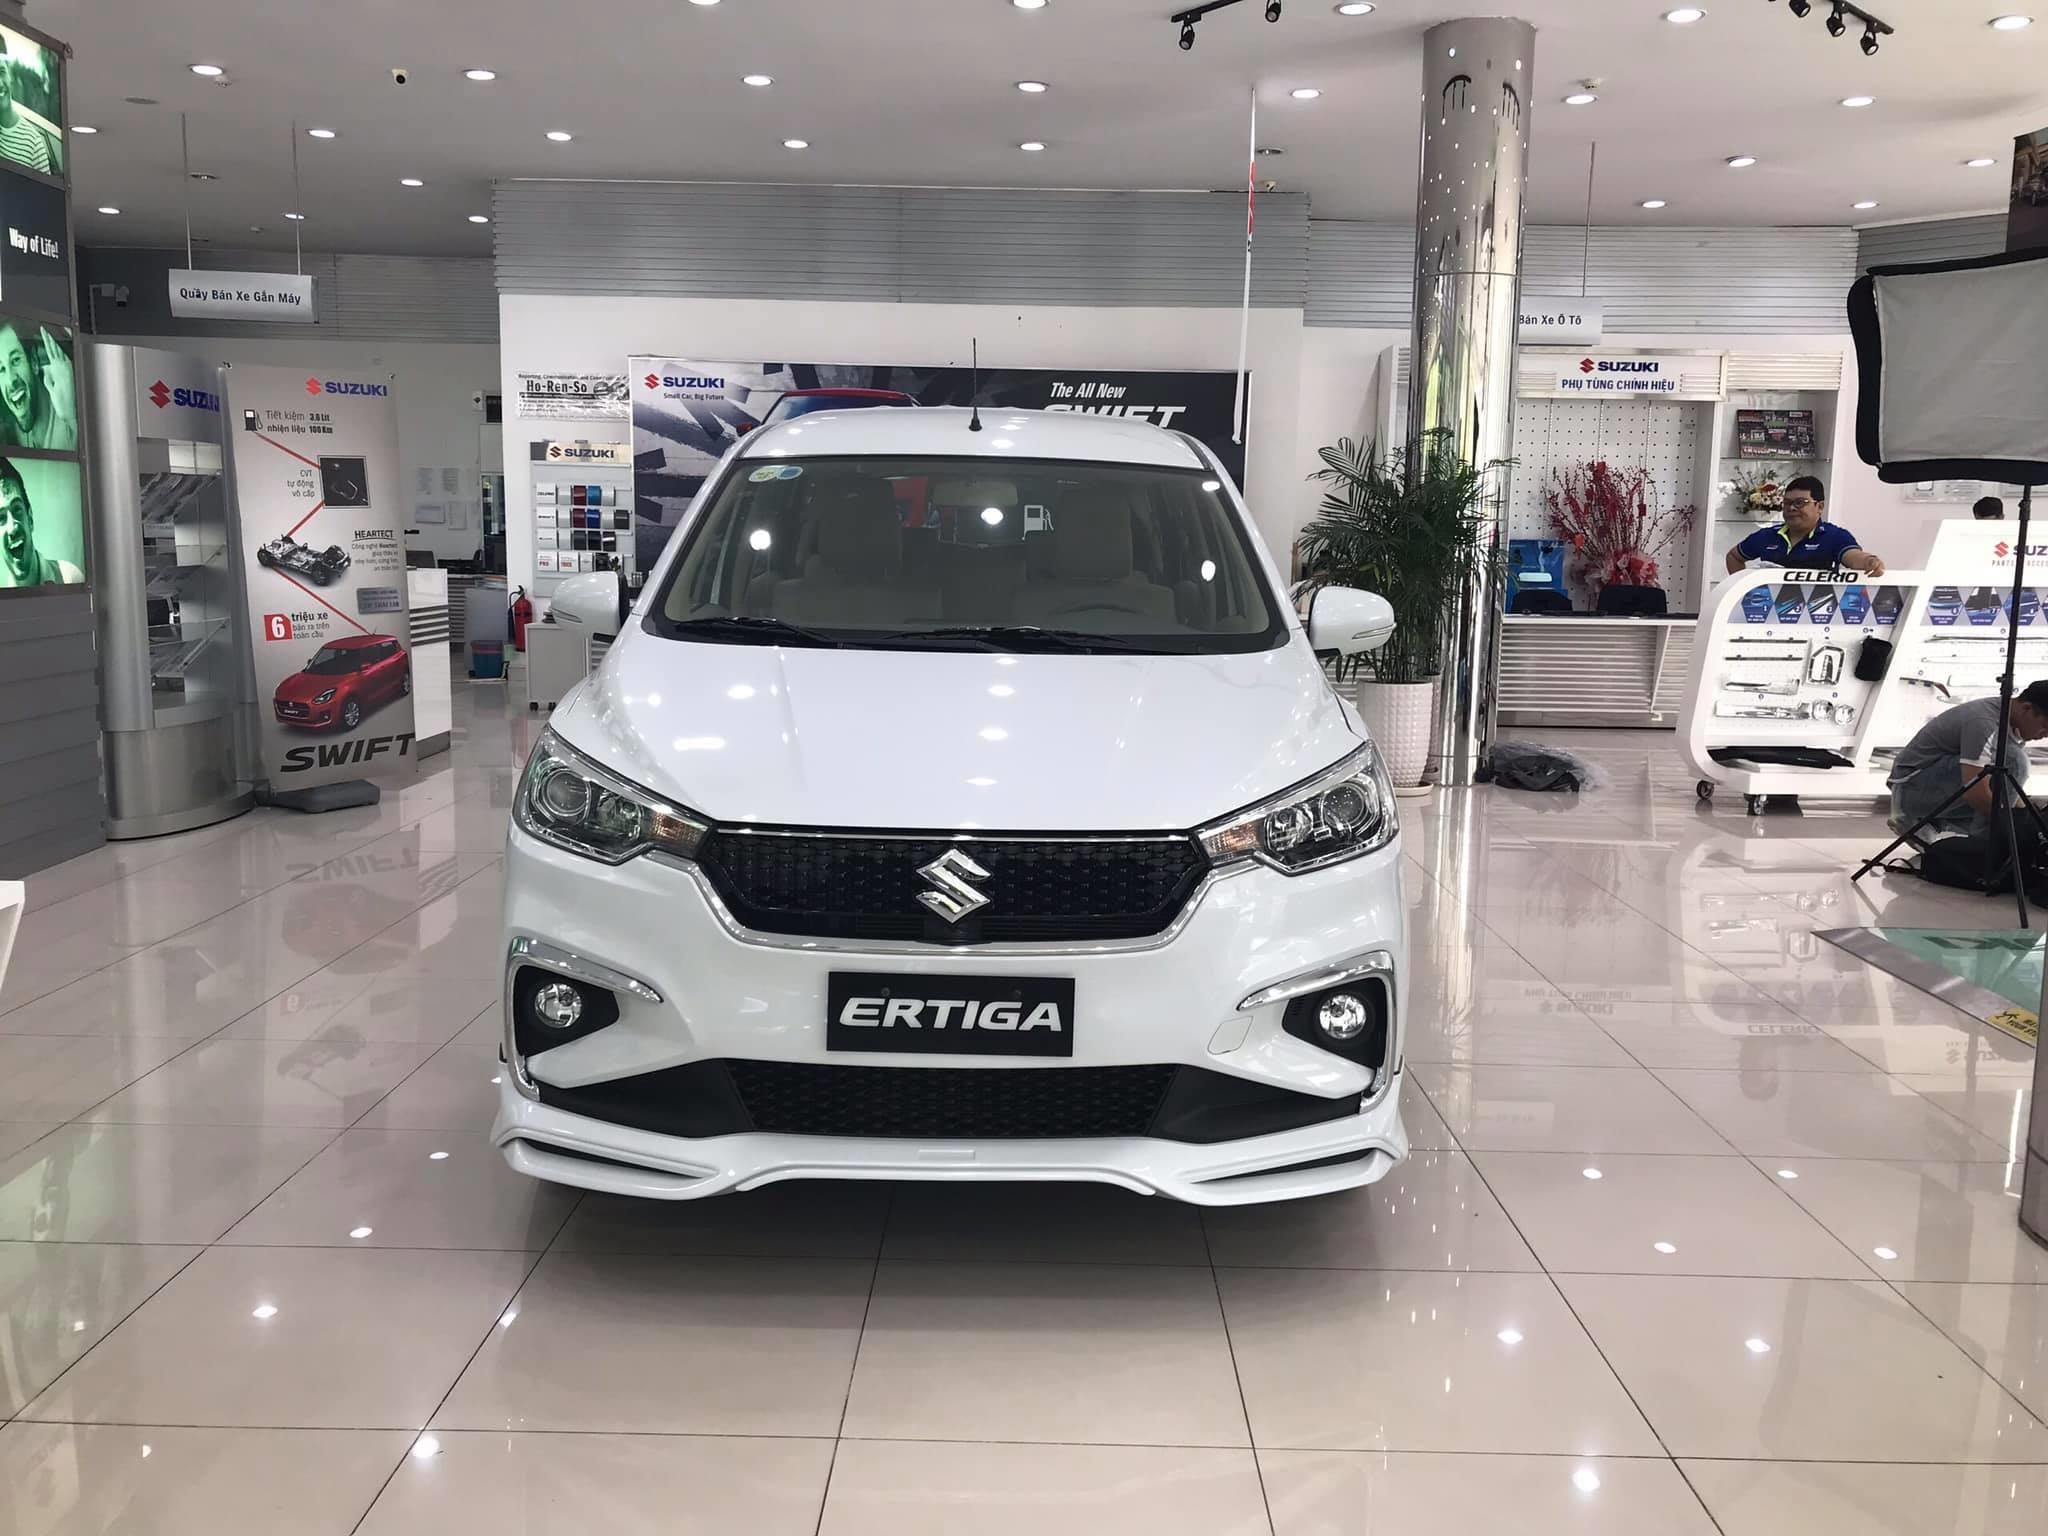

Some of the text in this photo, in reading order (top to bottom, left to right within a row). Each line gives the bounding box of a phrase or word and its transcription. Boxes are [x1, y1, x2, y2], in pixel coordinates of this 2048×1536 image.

[9, 227, 59, 259] Way of Life!
[212, 289, 232, 300] Bán
[236, 290, 250, 301] Xe
[278, 292, 301, 306] Máy
[1541, 314, 1554, 325] Xe
[1558, 313, 1566, 325] Ô
[1598, 361, 1659, 372] SUZUKI
[325, 382, 388, 397] SUZUKI
[527, 380, 587, 393] Ho-Ren-So
[663, 376, 725, 389] SUZUKI
[1562, 379, 1583, 391] PHỤ
[1616, 377, 1649, 390] CHÍNH
[1651, 378, 1675, 392] HIỆU
[1050, 382, 1127, 399] The All New
[564, 449, 614, 458] SUZUKI
[300, 469, 312, 477] CVT
[1784, 571, 1858, 583] CELERIO
[291, 612, 328, 623] triệu xe
[272, 616, 285, 638] 6
[280, 733, 415, 773] SWIFT
[839, 997, 1062, 1032] ERTIGA
